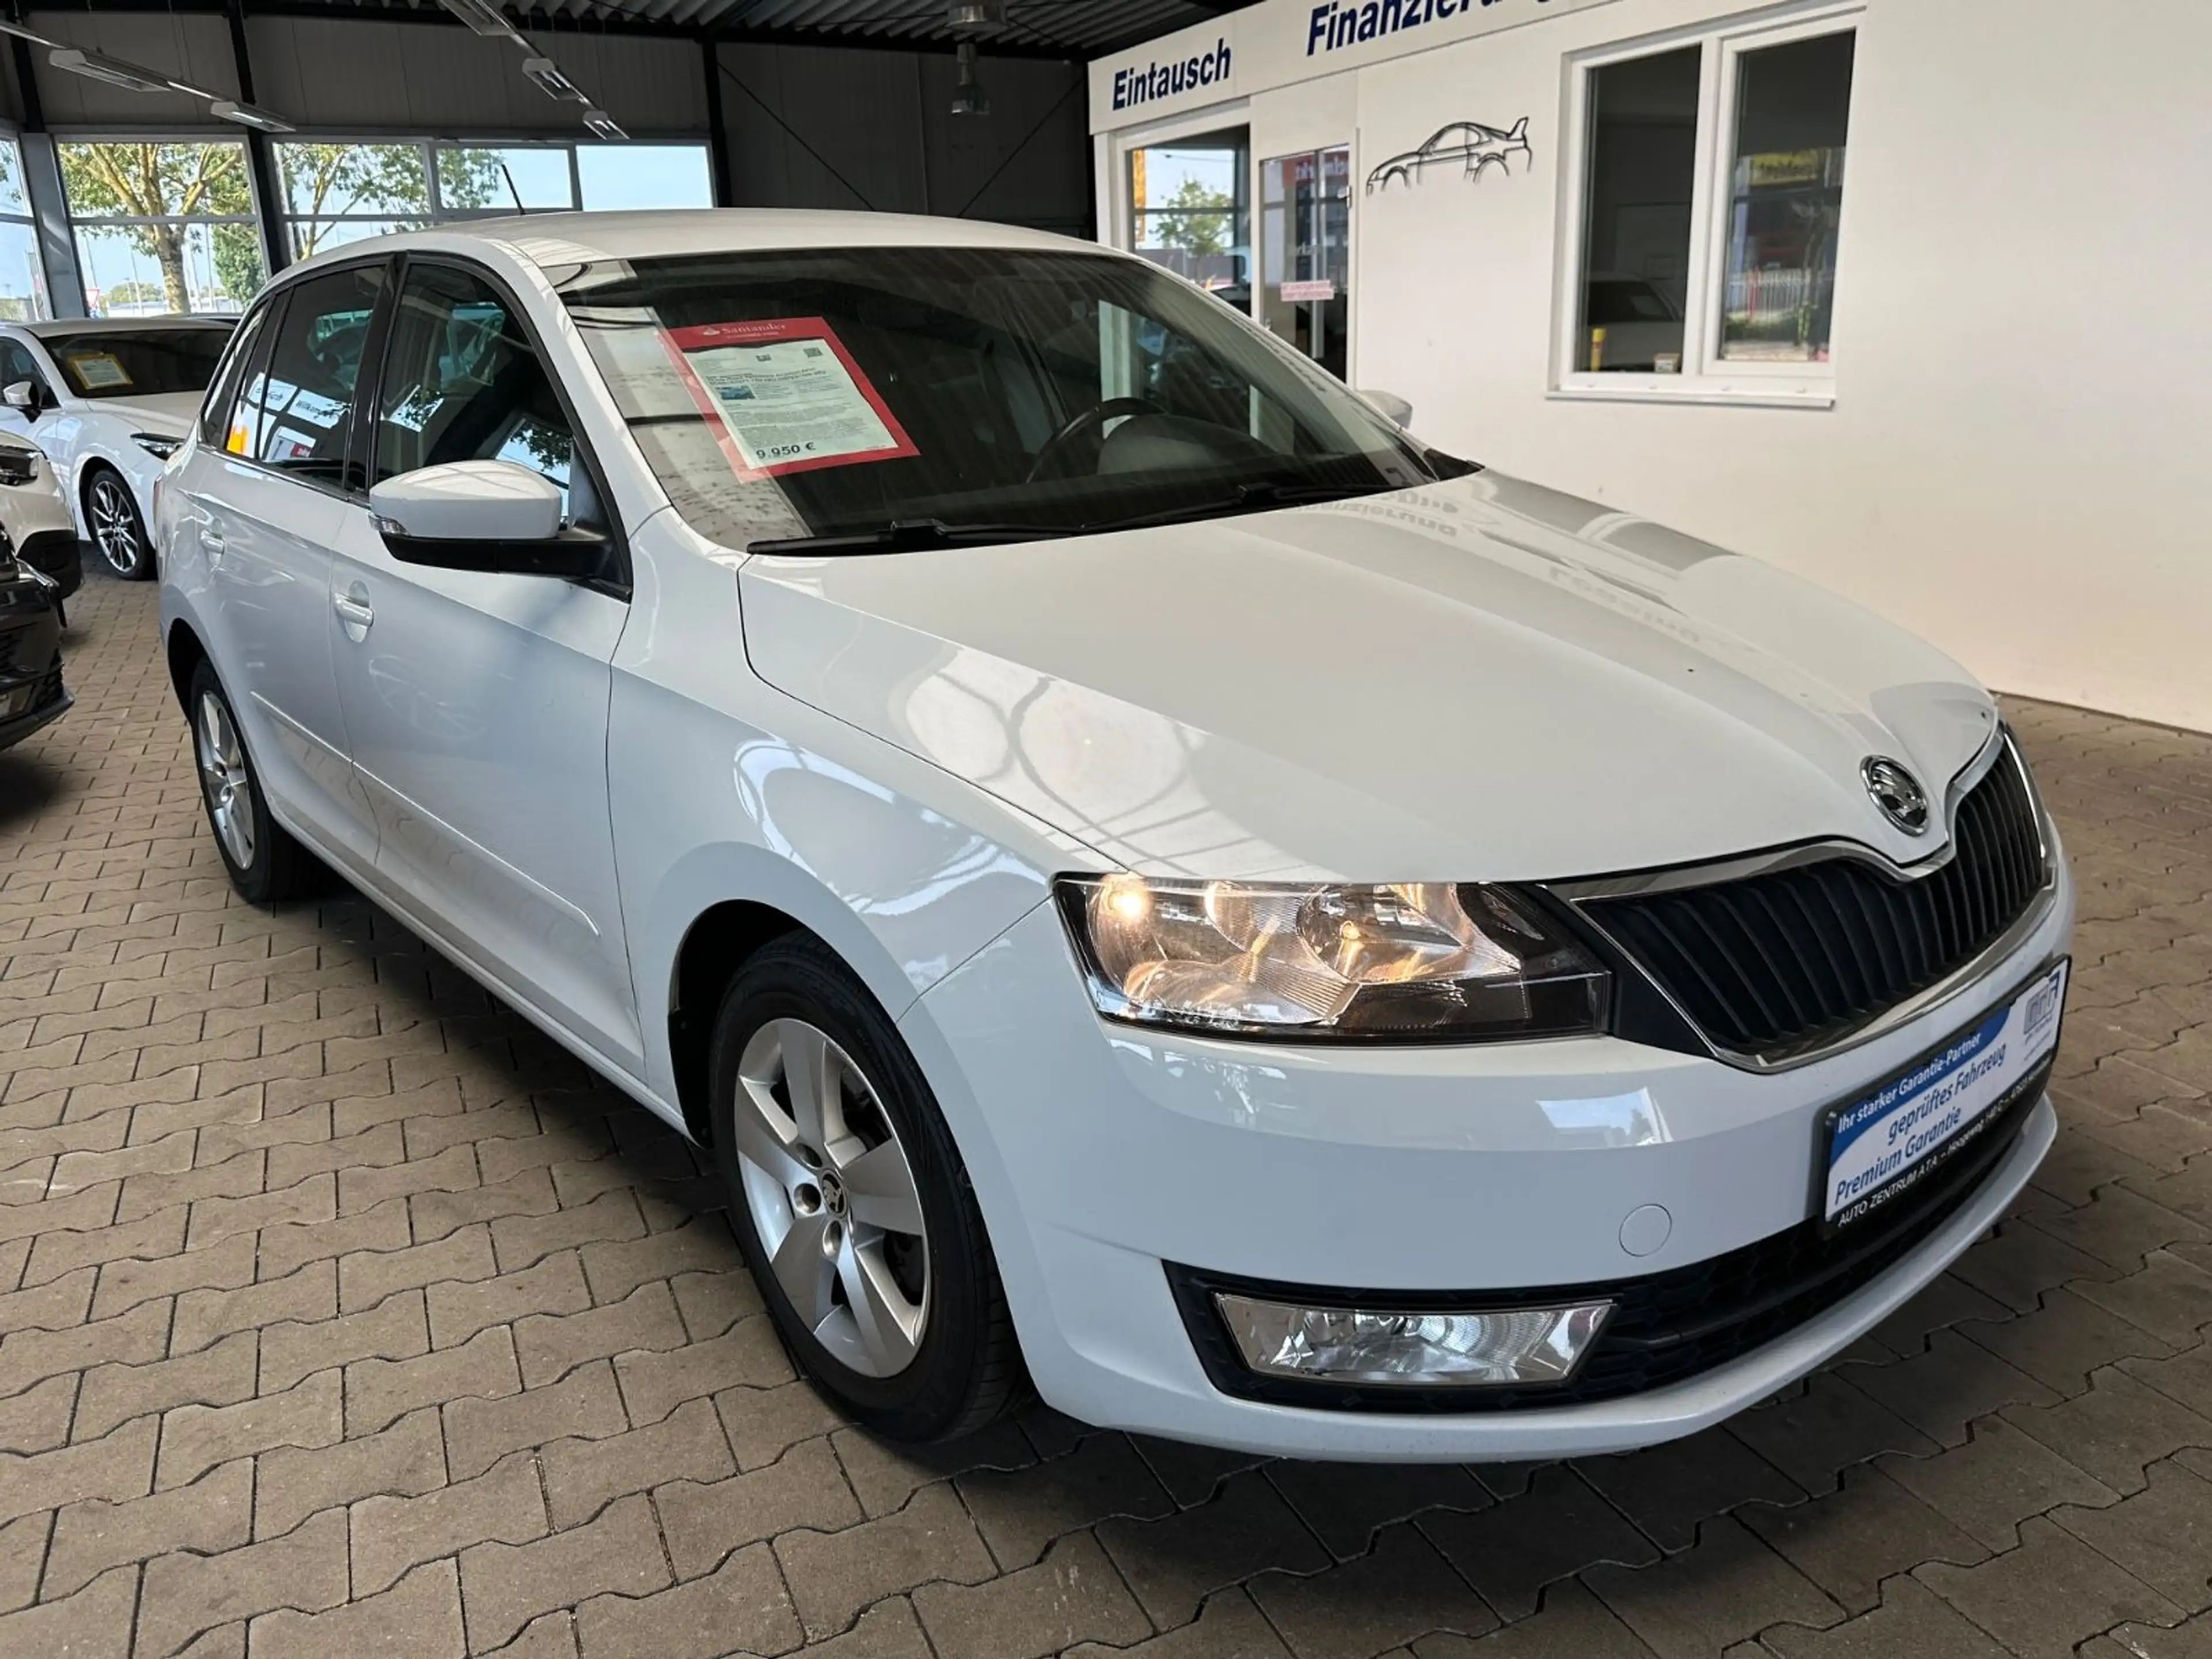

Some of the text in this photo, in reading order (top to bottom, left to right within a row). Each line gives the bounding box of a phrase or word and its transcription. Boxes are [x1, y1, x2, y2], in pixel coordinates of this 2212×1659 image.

[1112, 39, 1232, 111] Eintausch
[721, 323, 786, 335] Santander
[805, 441, 816, 451] €
[1838, 1032, 1982, 1134] Ihr starker Garantie-Partner
[1887, 1084, 1953, 1146] geprüftes
[1953, 1043, 2007, 1096] Fahrzeug
[1835, 1106, 1961, 1206] Premium Garantie
[1838, 1200, 1868, 1228] AUTO
[1869, 1170, 1918, 1209] ZENTRUM
